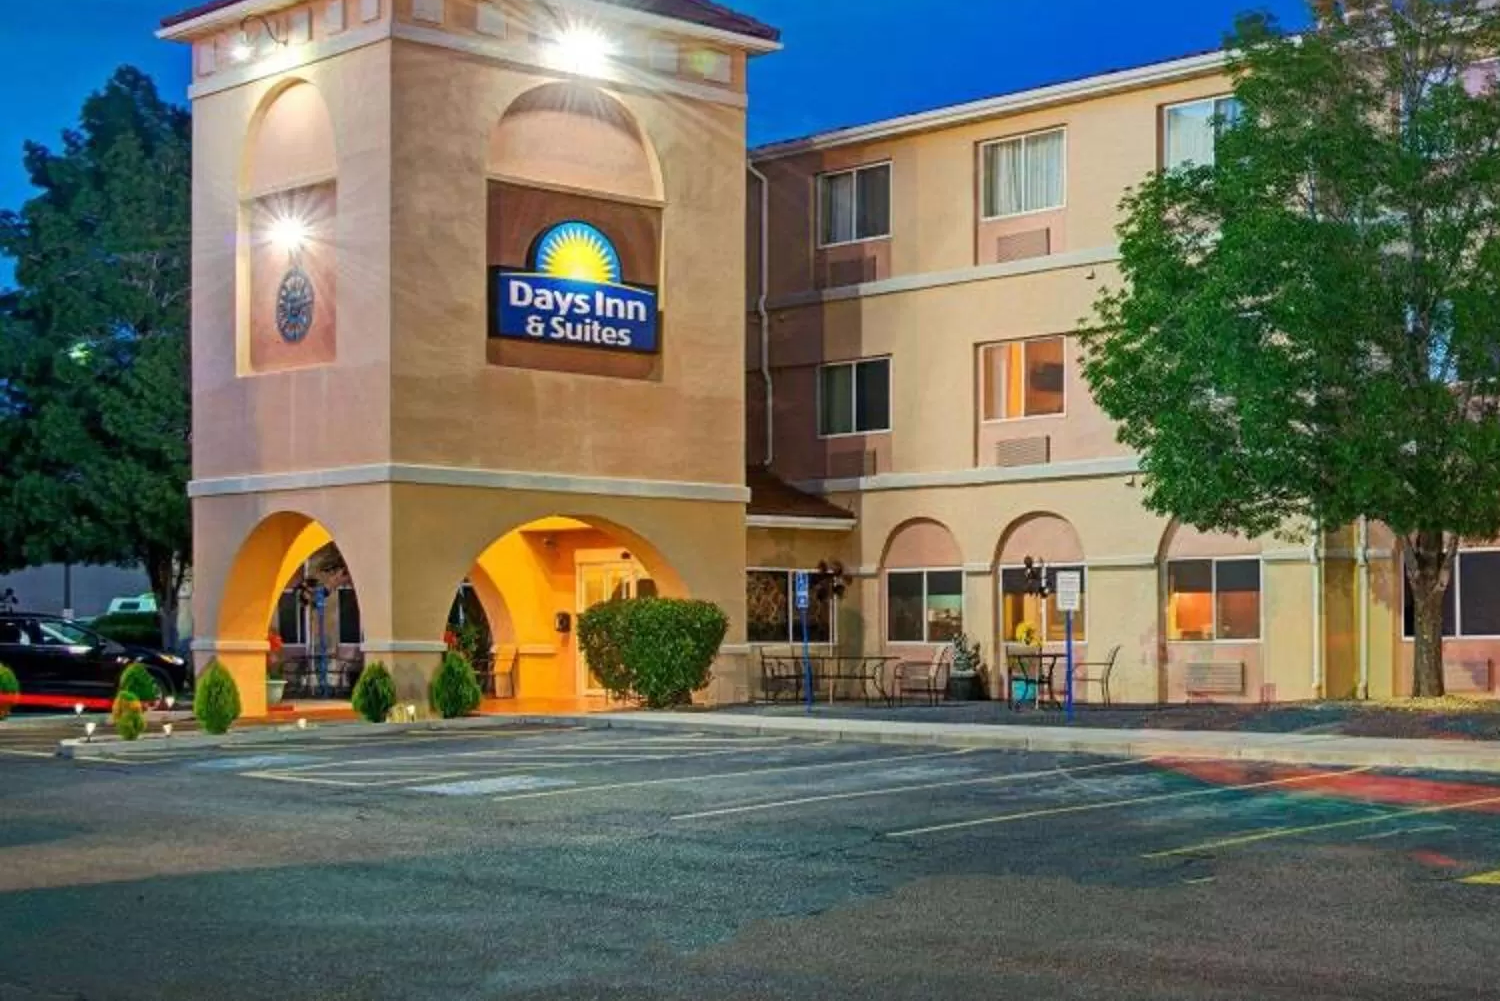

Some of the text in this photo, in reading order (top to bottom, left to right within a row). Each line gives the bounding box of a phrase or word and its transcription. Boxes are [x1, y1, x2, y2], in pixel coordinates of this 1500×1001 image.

[509, 279, 647, 321] Days Inn
[525, 314, 632, 346] & Suites
